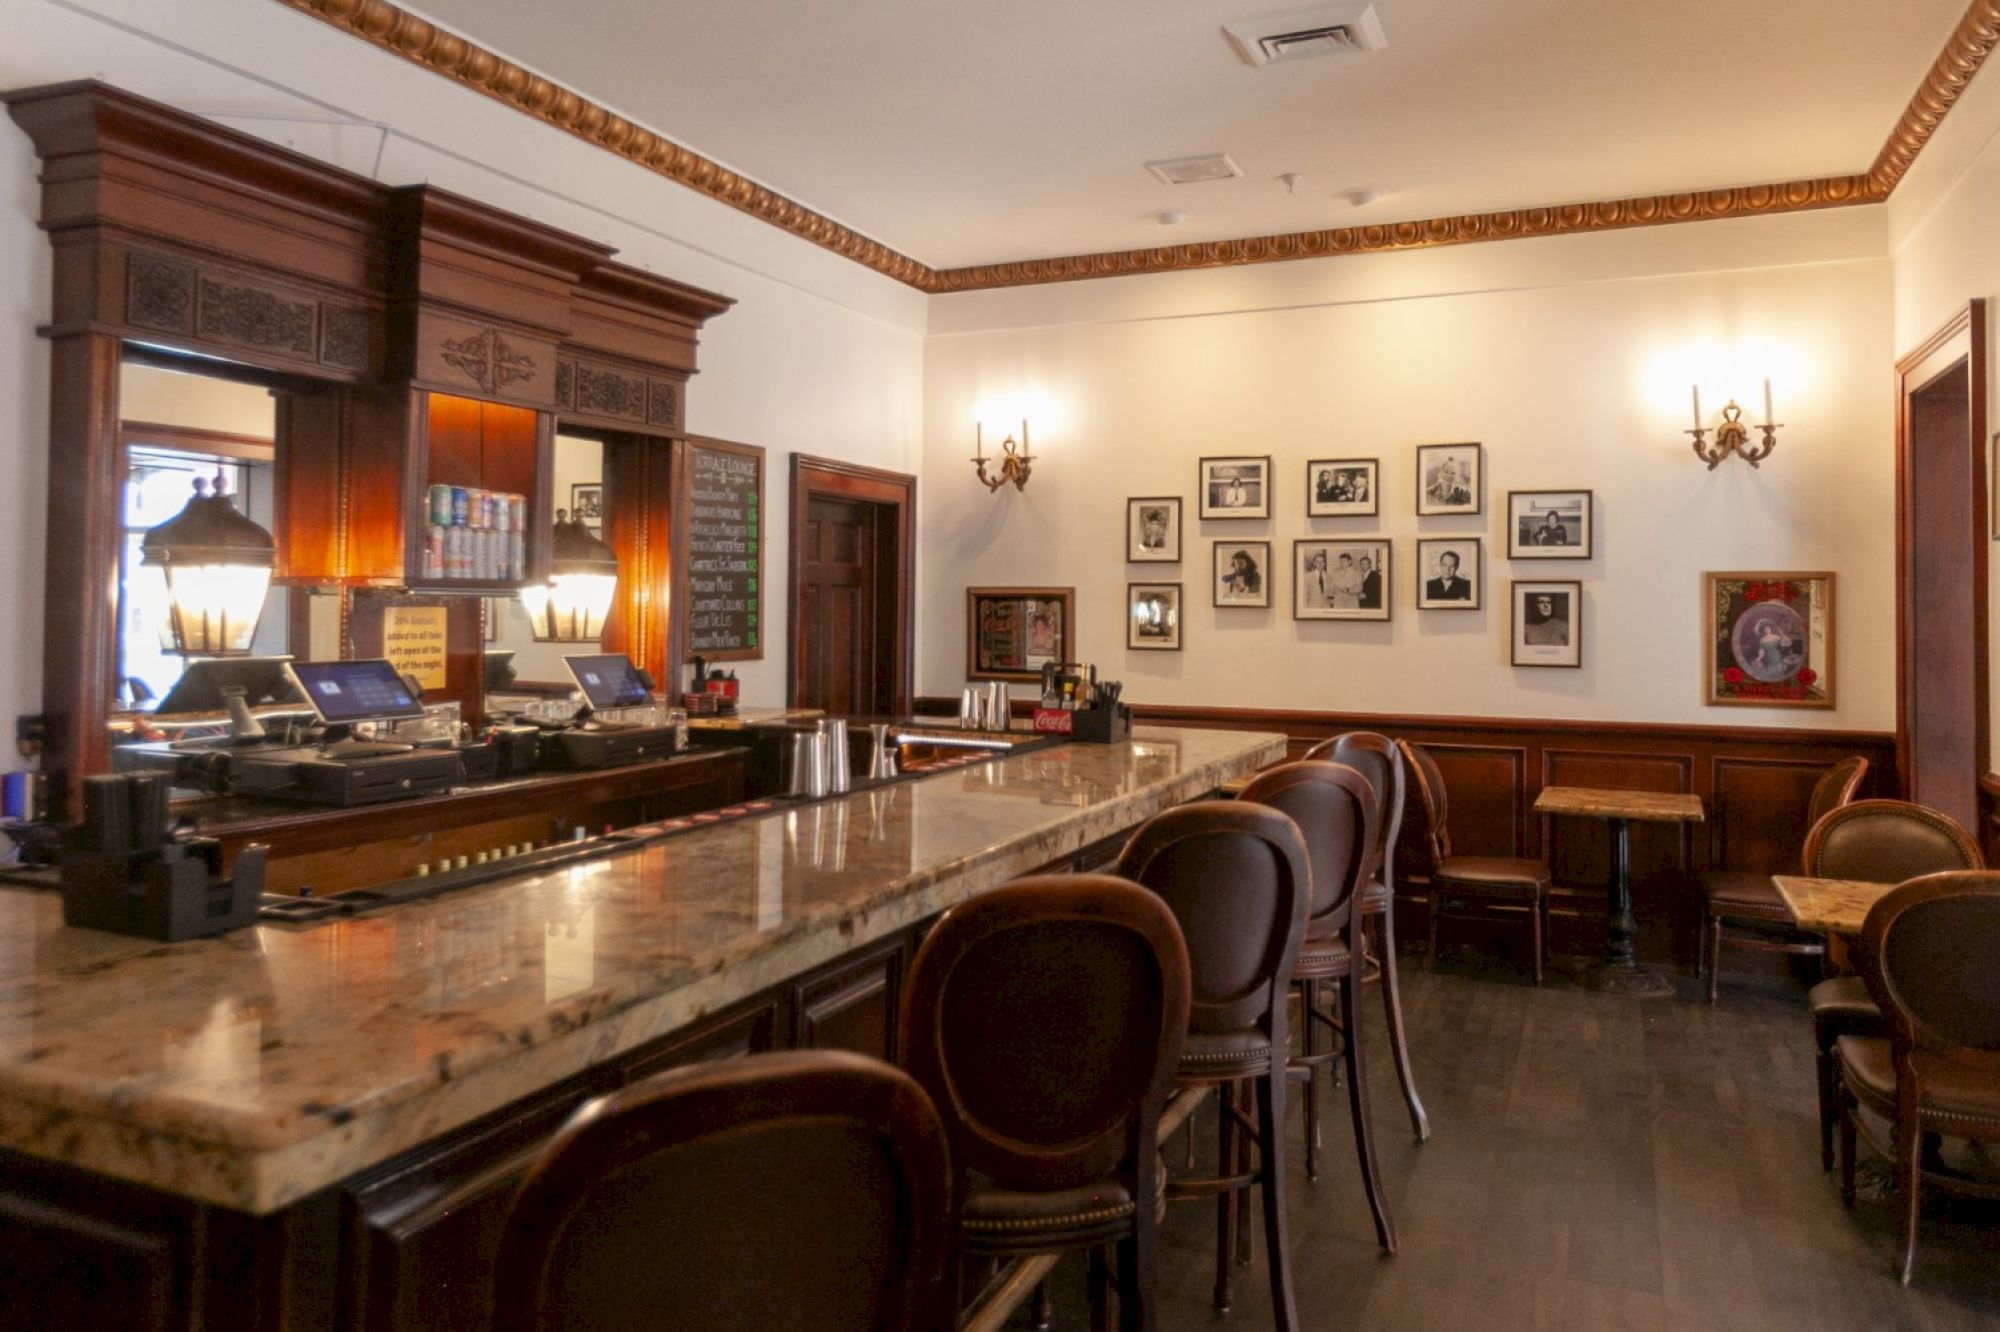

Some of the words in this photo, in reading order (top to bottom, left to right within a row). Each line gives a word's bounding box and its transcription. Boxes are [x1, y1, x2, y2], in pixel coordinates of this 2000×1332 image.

[728, 456, 758, 476] LOUNGE
[387, 632, 409, 640] added
[418, 631, 428, 640] all
[389, 646, 402, 656] left
[404, 648, 421, 657] open
[422, 647, 429, 655] at
[430, 646, 442, 654] the
[403, 660, 411, 669] of
[411, 660, 421, 669] the
